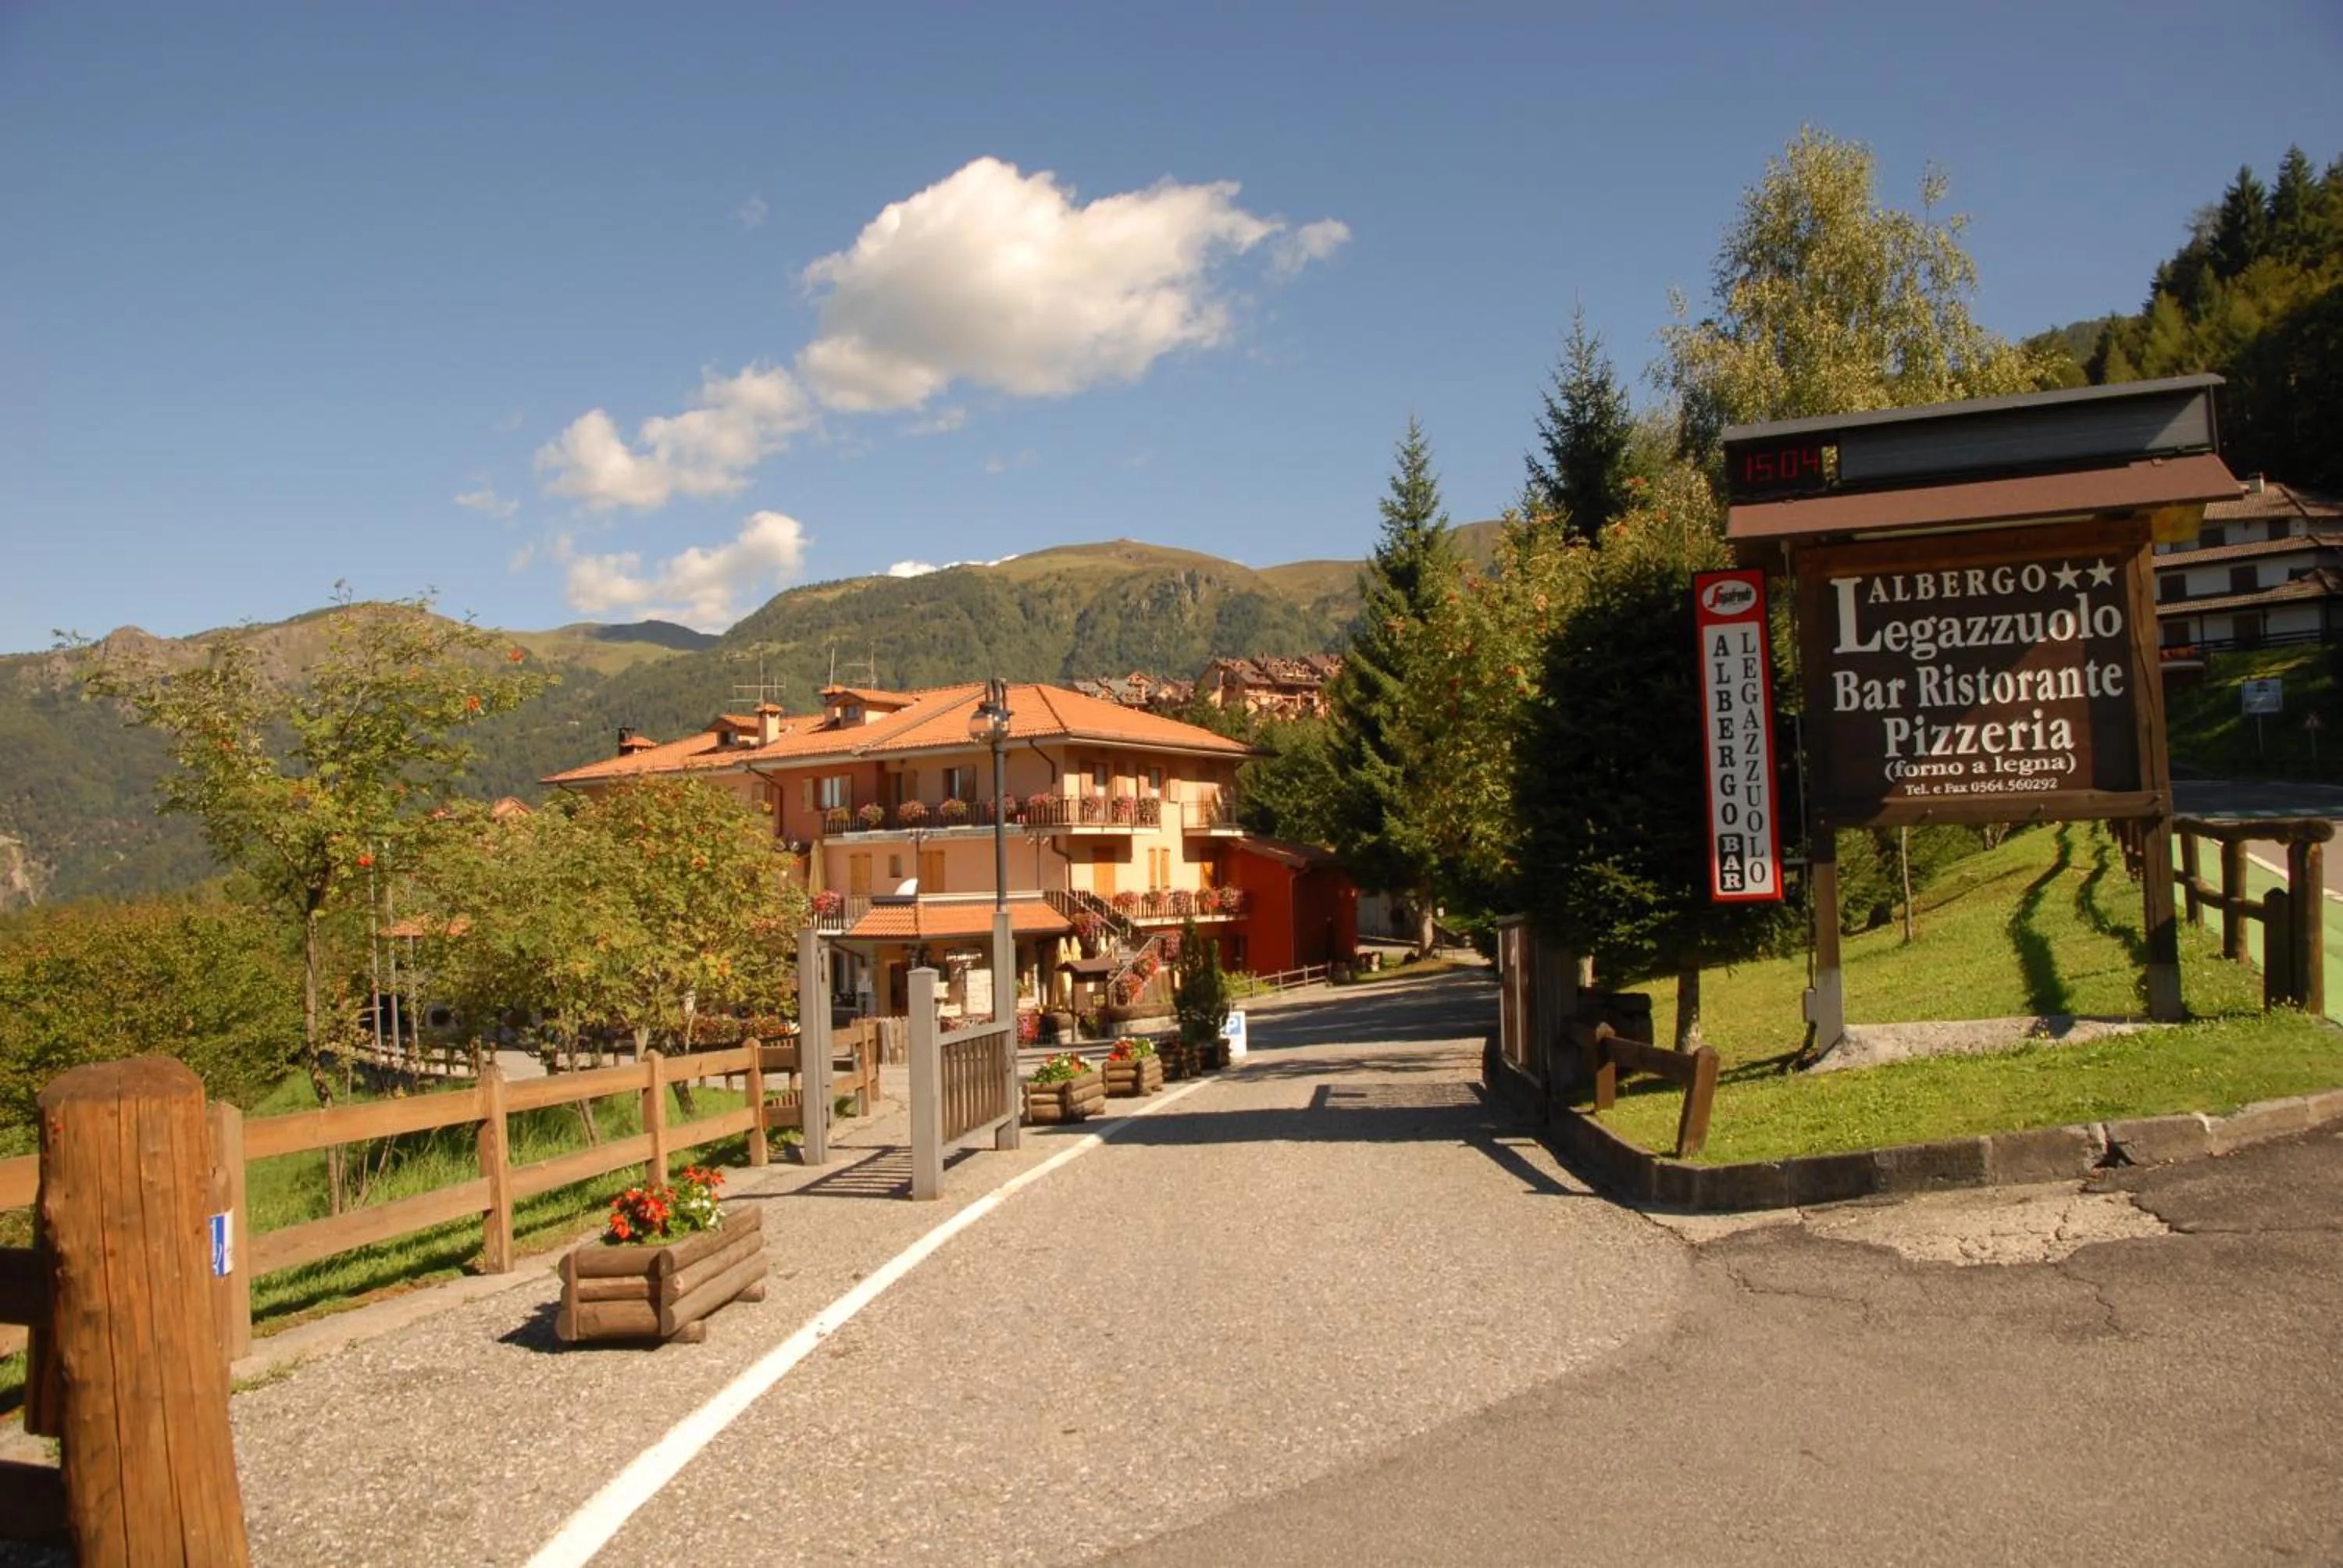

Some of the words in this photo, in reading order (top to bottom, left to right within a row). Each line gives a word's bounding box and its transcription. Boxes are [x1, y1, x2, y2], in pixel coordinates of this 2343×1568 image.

[1867, 564, 2047, 604] ALBERGO
[1830, 576, 2123, 661] Legazzuolo
[1832, 670, 1906, 711] Bar
[1916, 658, 2124, 708] Ristorante
[1713, 634, 1739, 827] ALBERGO
[1882, 707, 2076, 758] Pizzeria
[1741, 632, 1767, 885] LEGAZZUOLO
[1884, 760, 1965, 782] (forno
[1972, 762, 1988, 775] a
[1993, 752, 2077, 775] legna)
[1722, 838, 1742, 889] BAR
